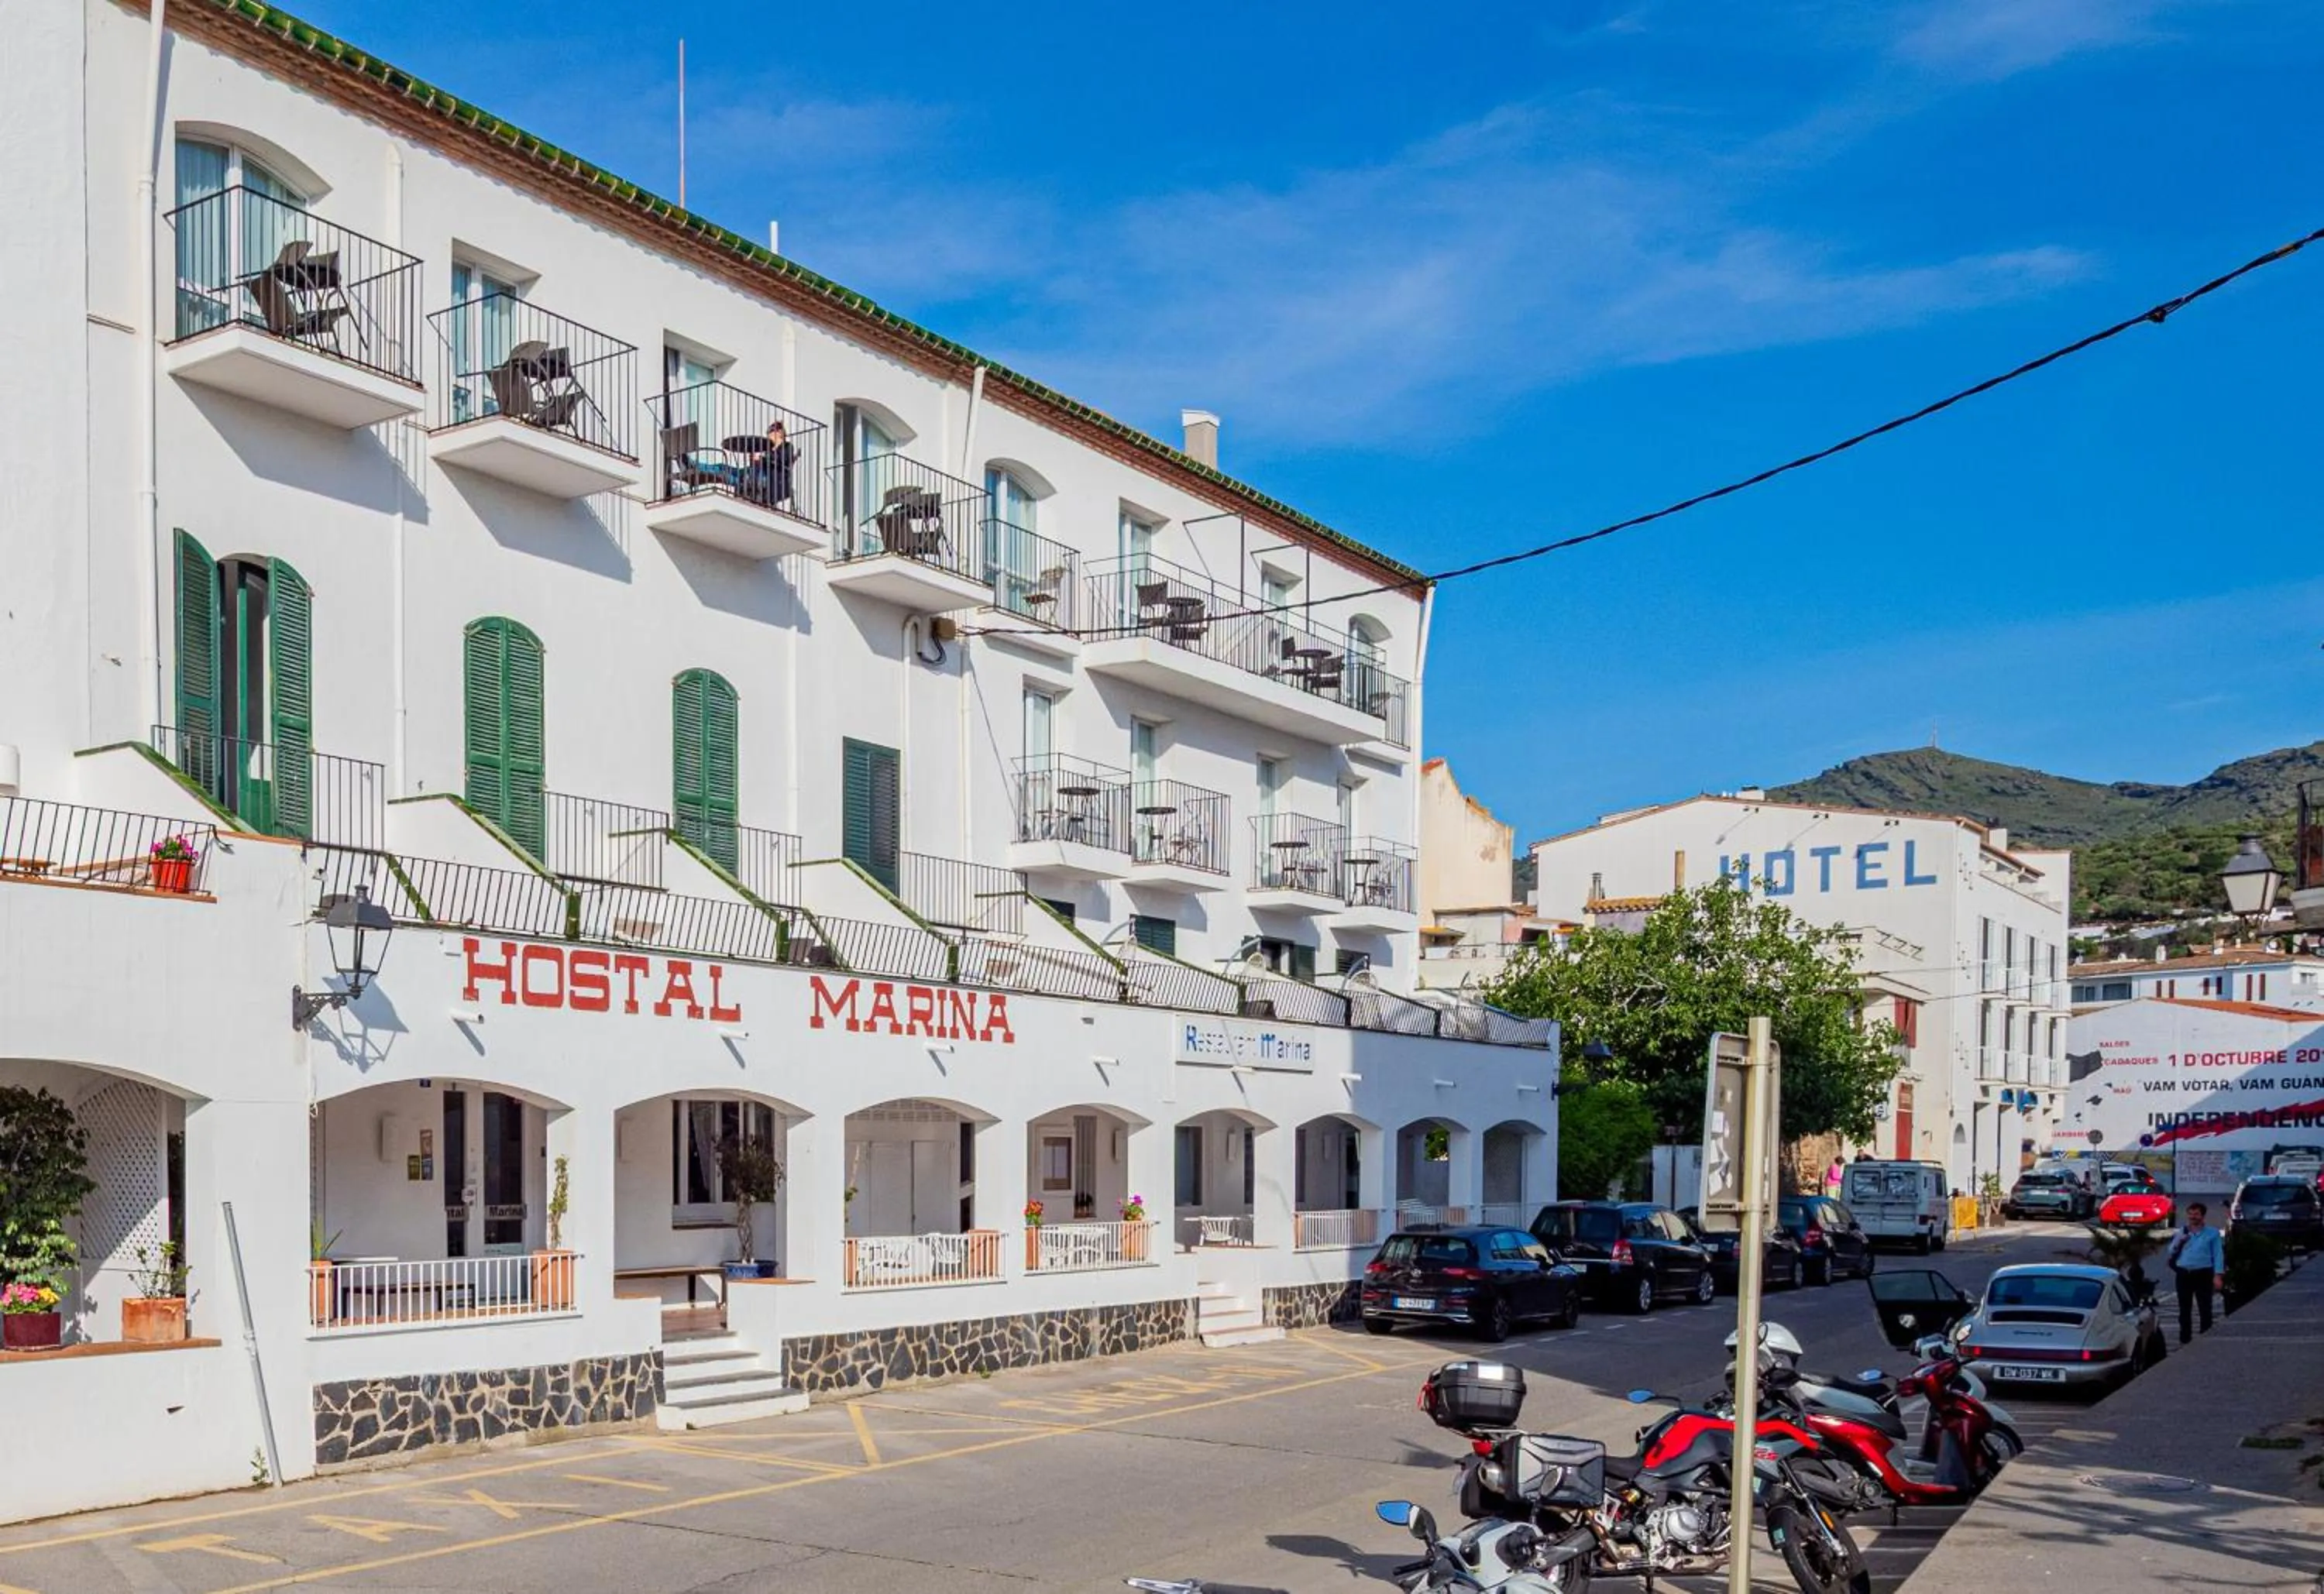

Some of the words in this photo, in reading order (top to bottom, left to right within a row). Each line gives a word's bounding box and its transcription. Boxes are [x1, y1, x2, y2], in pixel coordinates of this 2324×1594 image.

[1719, 840, 1937, 896] HOTEL
[462, 937, 741, 1022] HOSTAL
[810, 976, 1016, 1043] MARINA
[2144, 1080, 2176, 1091] VAM
[2181, 1080, 2233, 1092] VOTAR,
[2240, 1078, 2274, 1090] VAM
[2168, 1054, 2176, 1067] 1
[138, 1474, 671, 1564] TAXI
